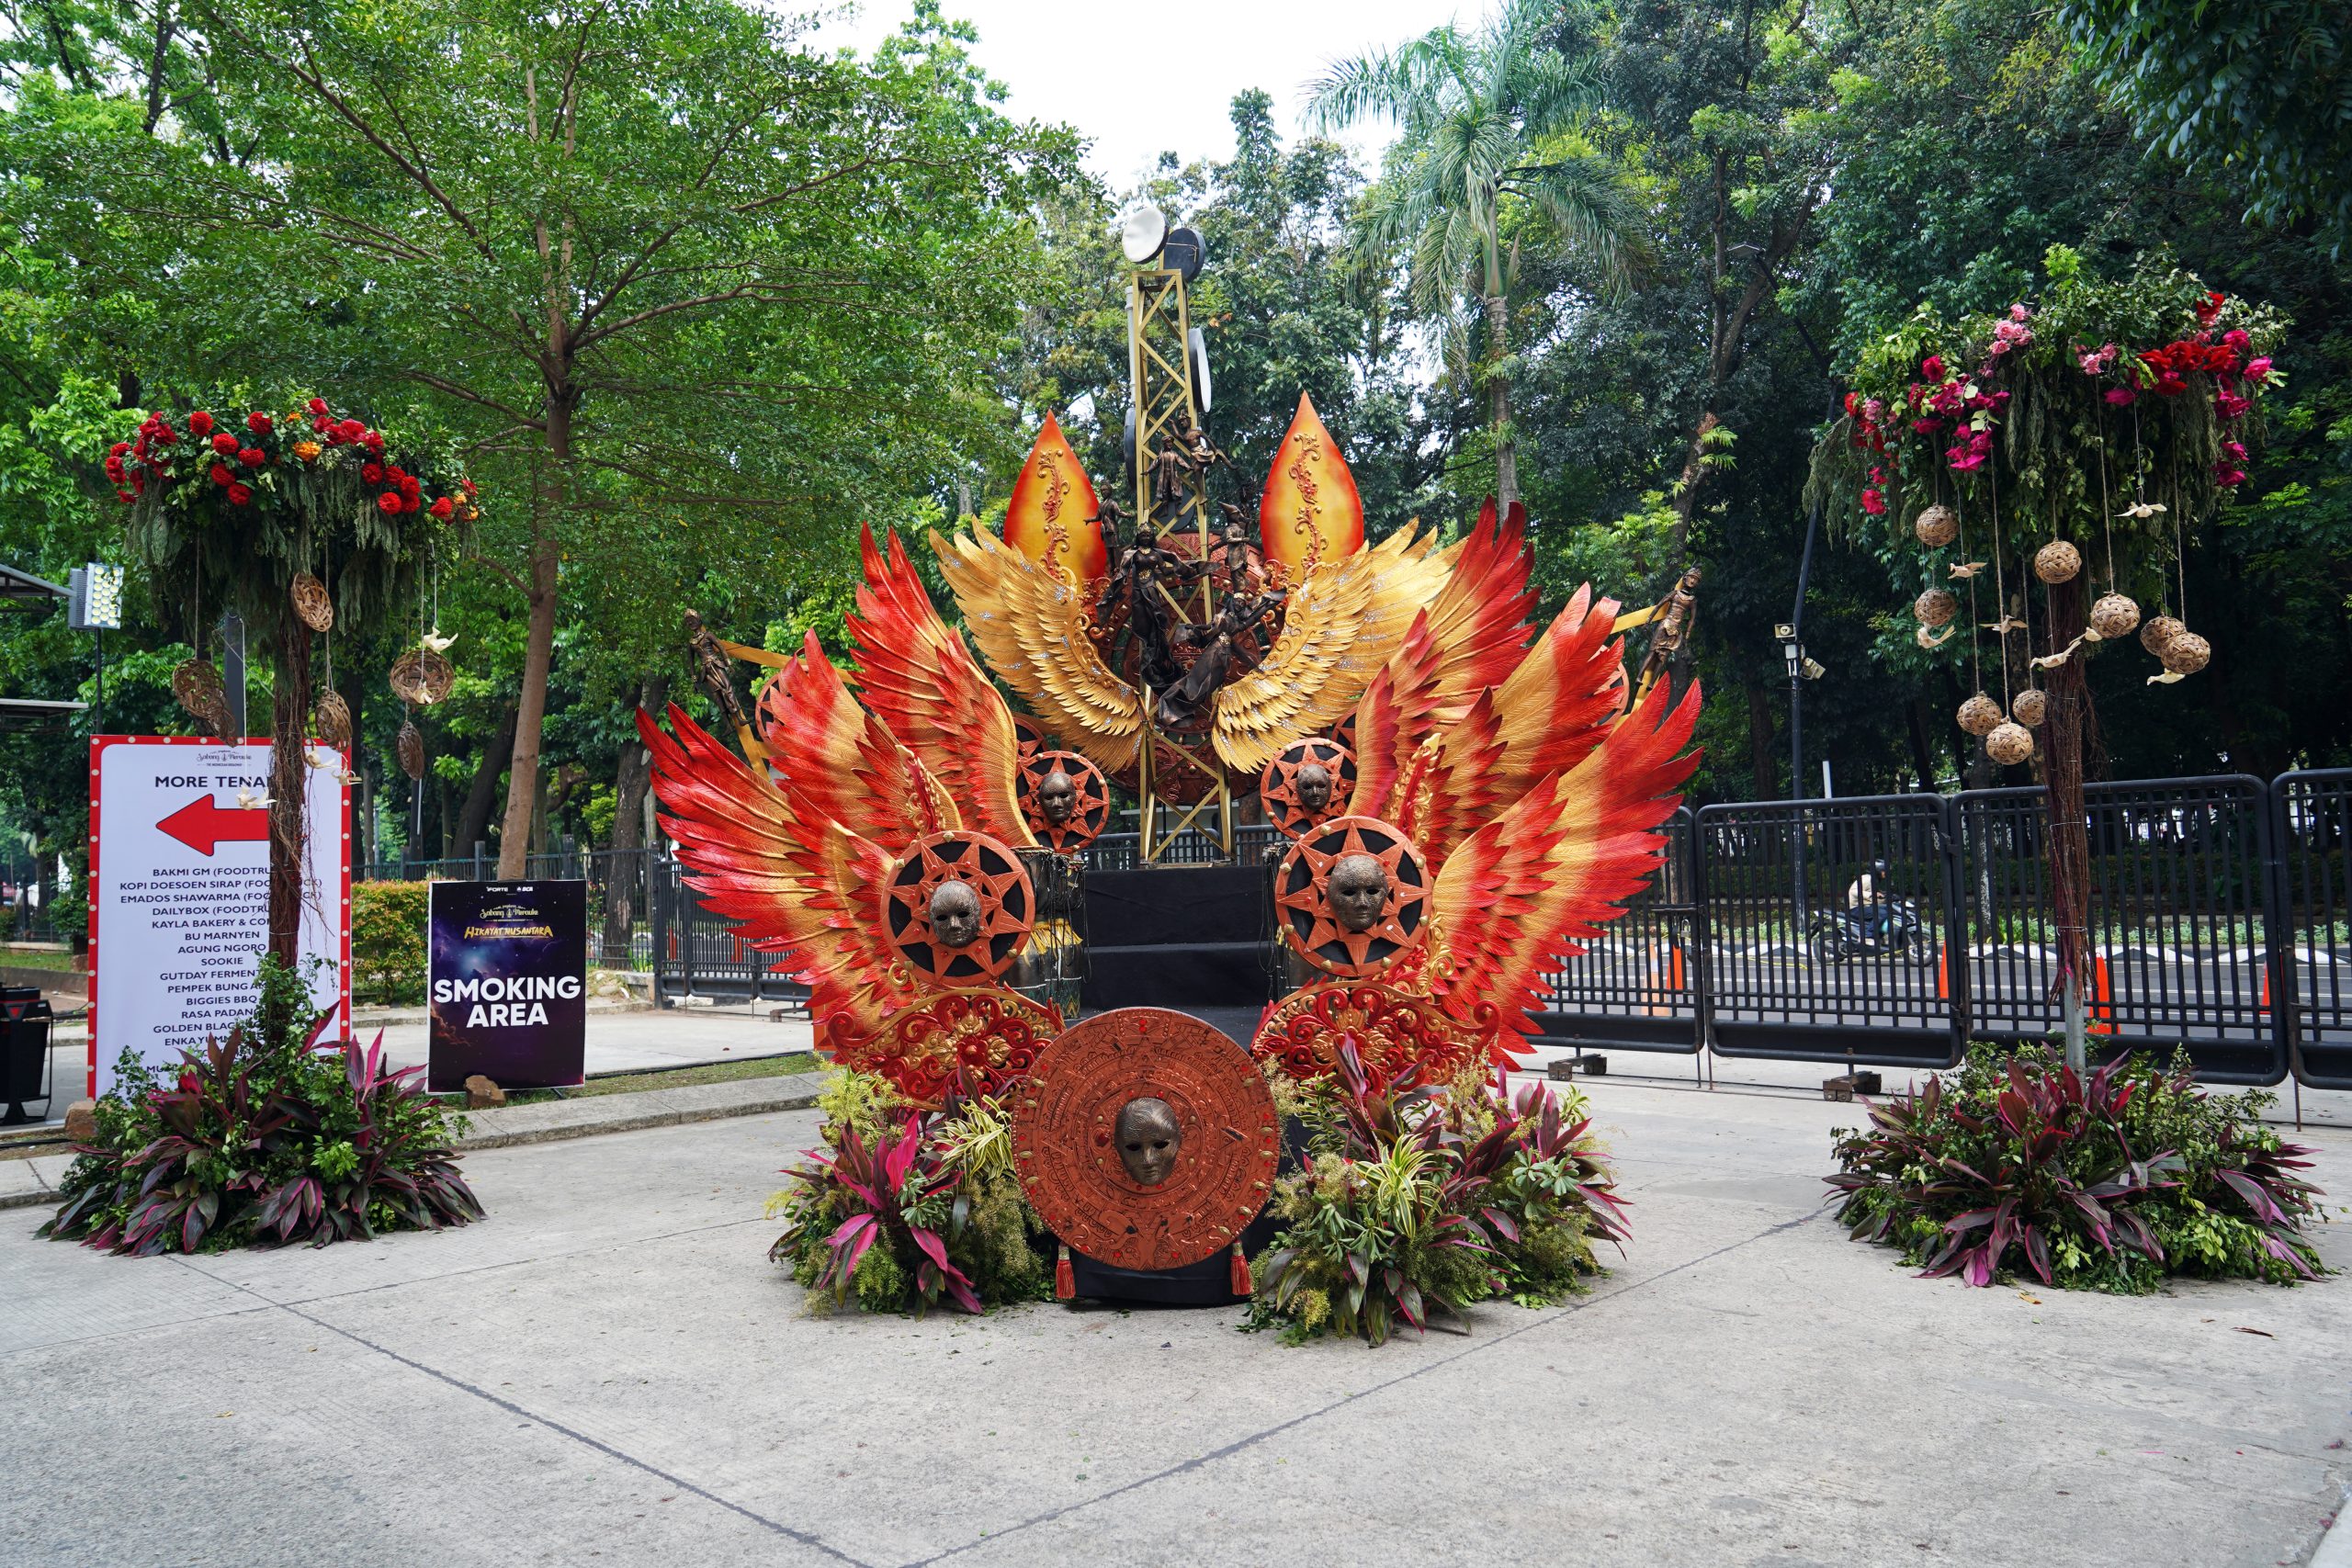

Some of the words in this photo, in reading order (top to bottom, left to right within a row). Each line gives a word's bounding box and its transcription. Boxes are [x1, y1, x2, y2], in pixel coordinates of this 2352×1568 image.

[155, 776, 208, 788] MORE
[215, 776, 270, 788] TENA
[153, 868, 189, 877] BAKMI
[192, 868, 210, 876] GM
[213, 866, 270, 878] (FOODTRU
[119, 881, 147, 890] KOPI
[150, 880, 207, 890] DOESOEN
[209, 879, 242, 889] SIRAP
[120, 895, 171, 904] EMADOS
[173, 893, 241, 902] SHAWARMA
[153, 906, 209, 916] DAILYBOX
[212, 905, 270, 917] (FOODTRU
[152, 919, 190, 929] KAYLA
[192, 919, 235, 928] BAKERY
[239, 919, 246, 927] &
[249, 918, 270, 926] CO
[185, 932, 200, 941] BU
[204, 931, 260, 940] MARNYEN
[464, 926, 503, 940] HIKAYAT
[504, 925, 554, 938] NUSANTARA
[177, 944, 221, 954] AGUNG
[224, 943, 266, 953] NGORO
[200, 956, 243, 966] SOOKIE
[160, 972, 209, 981] GUTDAY
[210, 969, 261, 979] FERMENT
[167, 984, 212, 994] PEMPEK
[215, 982, 248, 991] BUNG
[434, 976, 581, 1003] SMOKING
[186, 997, 231, 1006] BIGGIES
[233, 995, 257, 1004] BBQ
[181, 1010, 211, 1019] RASA
[466, 1003, 549, 1028] AREA
[153, 1023, 202, 1033] GOLDEN
[205, 1021, 235, 1031] BLAC
[164, 1037, 196, 1046] ENKA
